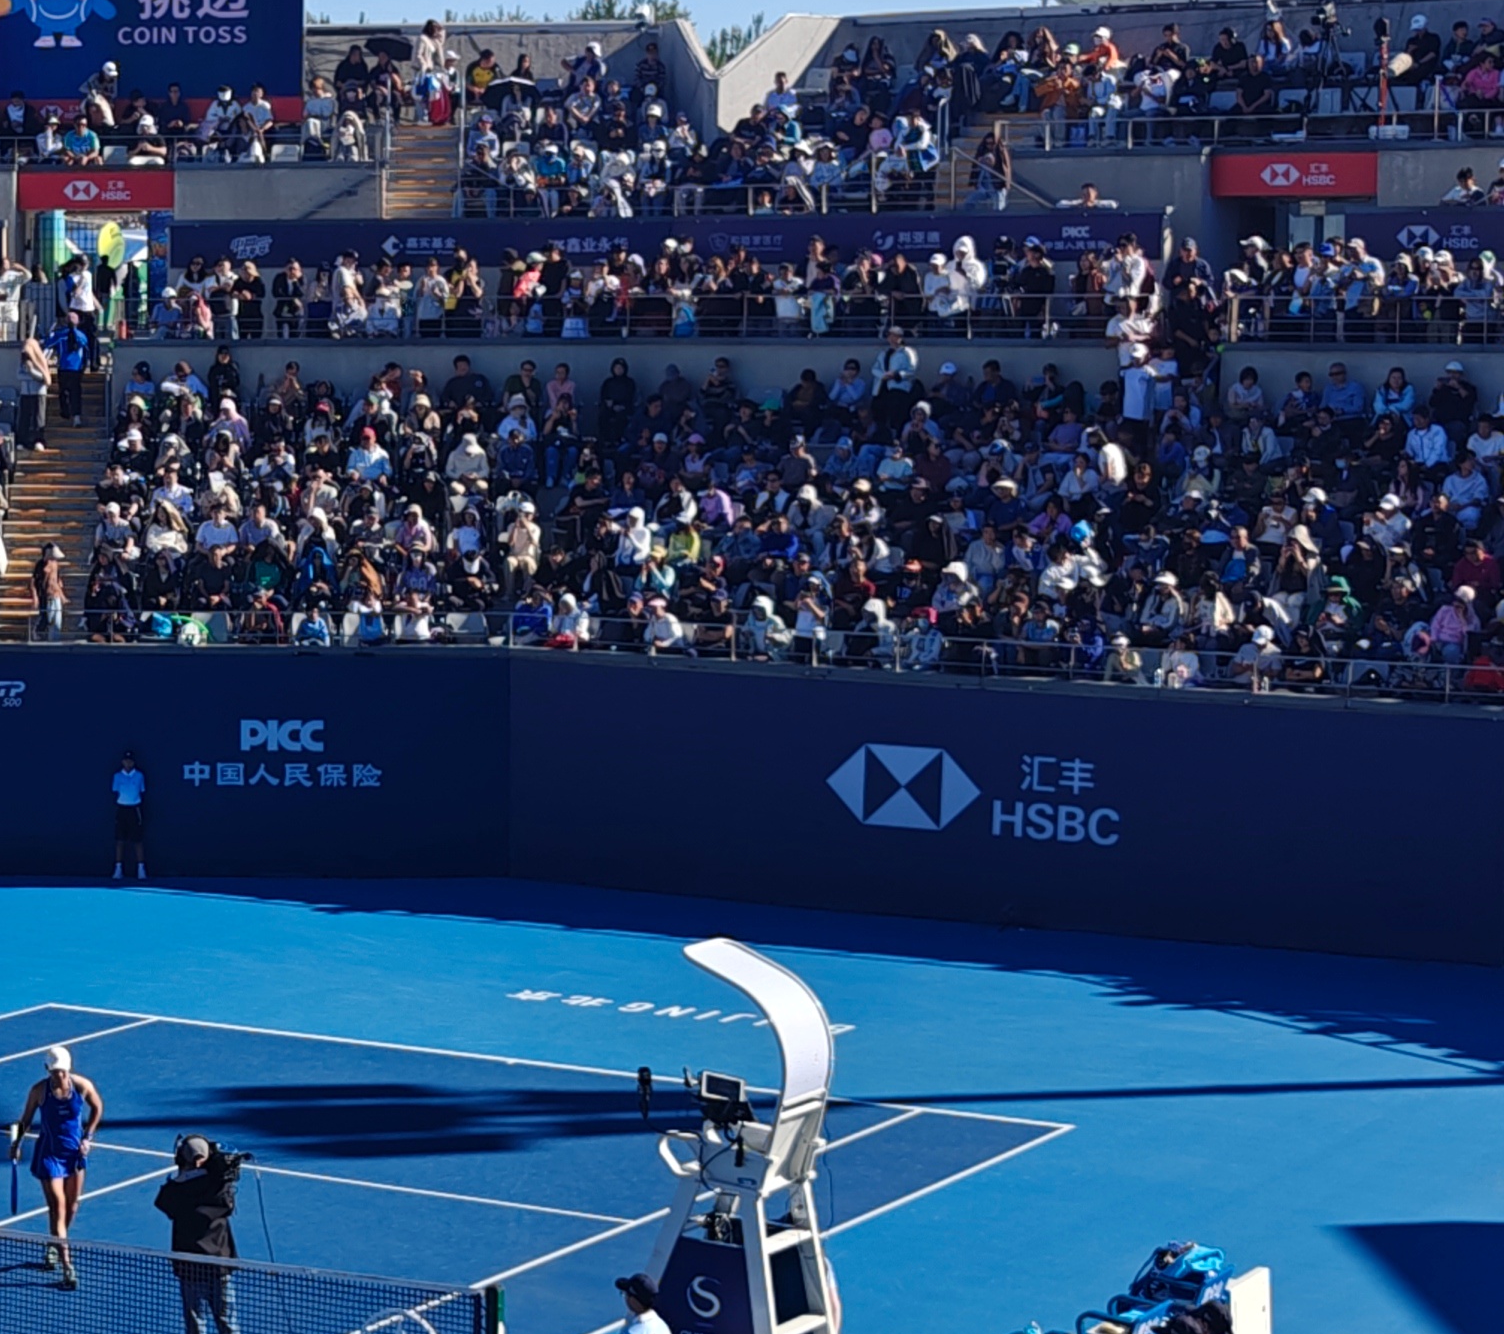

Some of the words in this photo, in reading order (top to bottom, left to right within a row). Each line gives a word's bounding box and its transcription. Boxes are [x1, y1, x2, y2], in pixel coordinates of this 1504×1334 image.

[117, 27, 177, 45] COIN
[183, 27, 247, 46] TOSS
[1302, 175, 1336, 186] HSBC
[101, 191, 131, 200] HSBC
[1062, 226, 1090, 238] PICC
[1443, 237, 1478, 248] HSBC
[2, 698, 22, 707] 500
[240, 720, 324, 752] PICC
[183, 761, 382, 788] 中国人民保险
[1021, 755, 1094, 795] 汇丰
[991, 799, 1120, 846] HSBC
